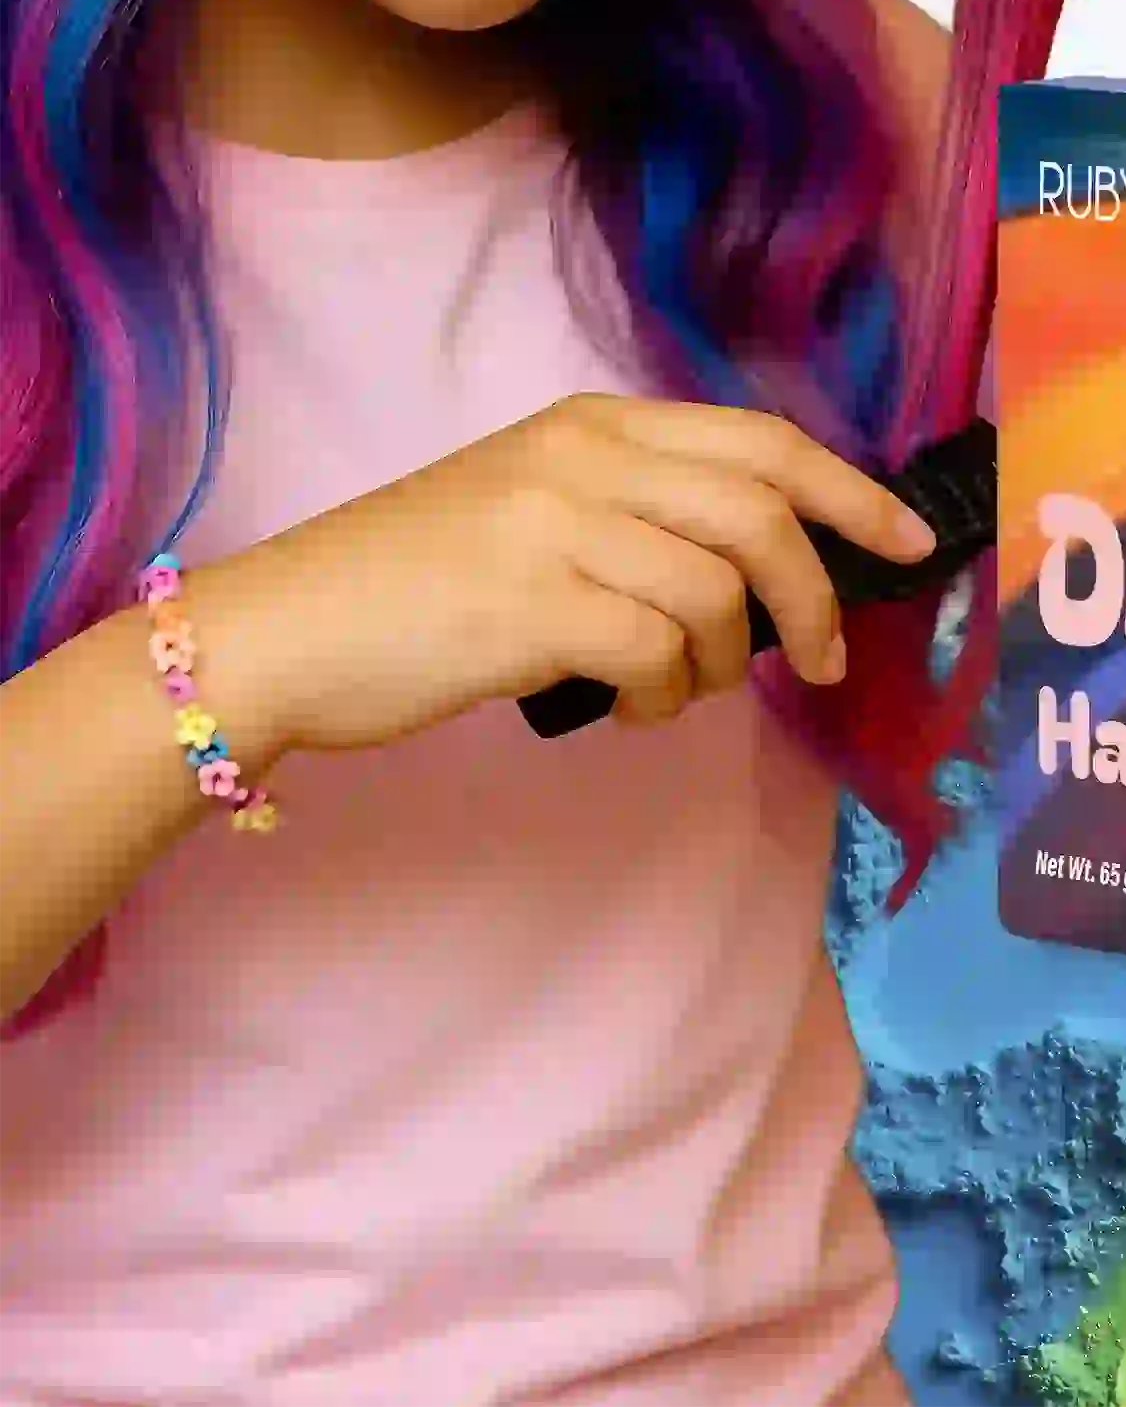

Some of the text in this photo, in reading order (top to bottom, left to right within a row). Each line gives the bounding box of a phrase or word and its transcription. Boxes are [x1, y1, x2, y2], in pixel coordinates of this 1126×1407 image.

[1035, 850, 1064, 879] Net
[1068, 855, 1095, 883] Wt.
[1100, 861, 1121, 887] 65
